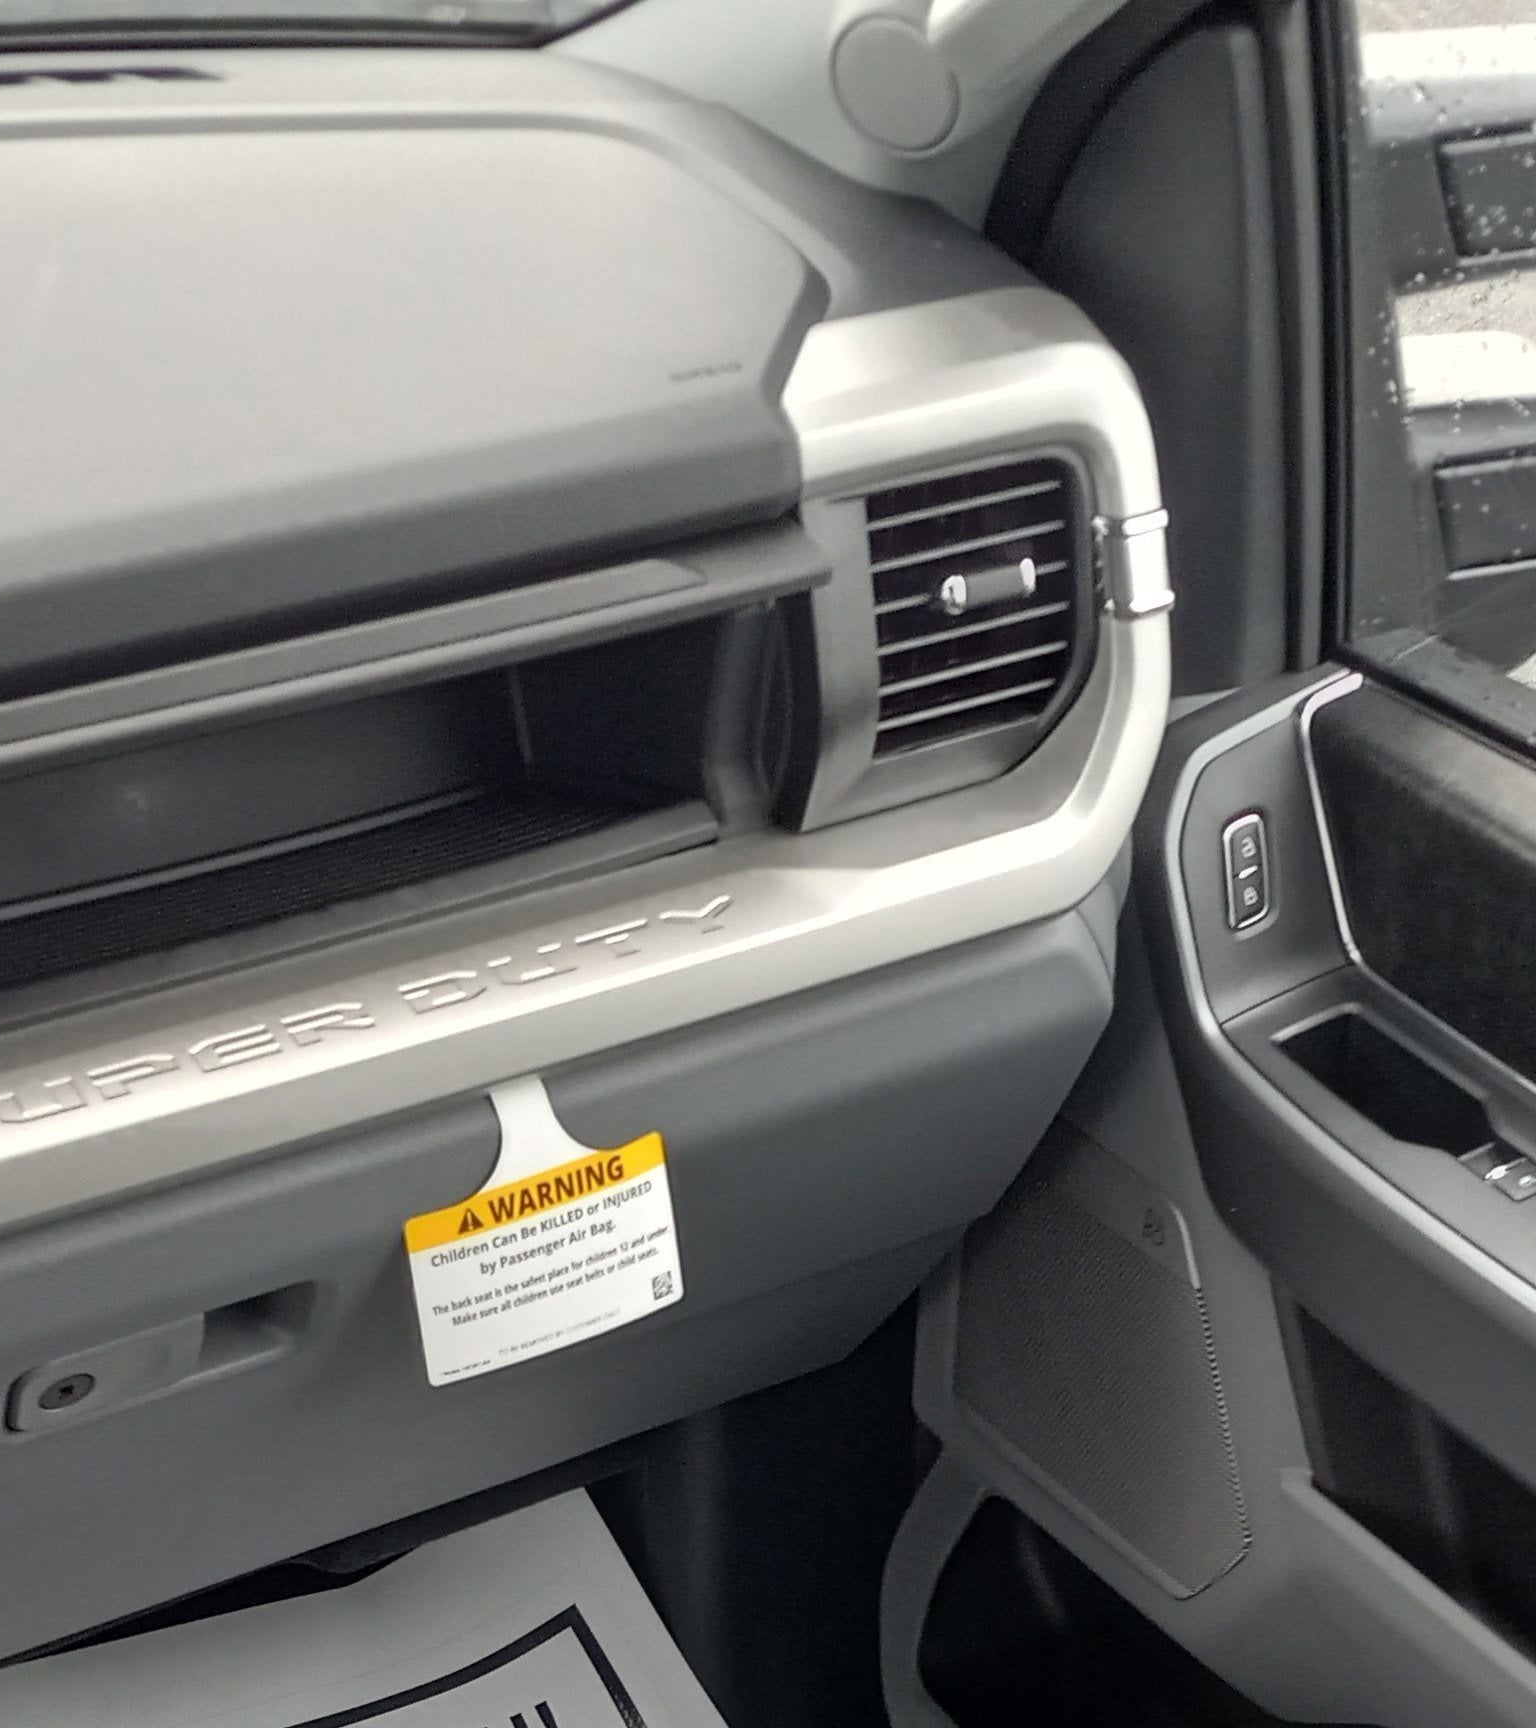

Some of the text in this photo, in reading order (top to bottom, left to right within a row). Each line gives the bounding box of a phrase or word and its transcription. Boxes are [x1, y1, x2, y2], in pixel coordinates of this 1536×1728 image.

[398, 894, 734, 1014] DUTY
[431, 1180, 652, 1267] Children Can Be KILLED or INJURED
[488, 1155, 624, 1225] WARNING
[432, 1304, 449, 1316] The
[451, 1296, 472, 1311] back
[474, 1291, 493, 1304] seat
[495, 1288, 503, 1298] is
[504, 1283, 519, 1295] the
[521, 1274, 545, 1289] safest
[548, 1266, 569, 1282] place
[571, 1260, 583, 1271] for
[585, 1247, 617, 1266] children
[631, 1235, 645, 1248] and
[452, 1312, 477, 1326] Make
[480, 1306, 498, 1318] sure
[500, 1300, 512, 1312] all
[513, 1290, 548, 1307] children
[549, 1285, 564, 1295] use
[565, 1277, 583, 1289] seat
[585, 1269, 605, 1282] belts
[606, 1264, 615, 1274] or
[617, 1255, 636, 1270] child
[480, 1261, 497, 1276] by
[499, 1238, 565, 1268] Passenger
[569, 1229, 586, 1245] Air
